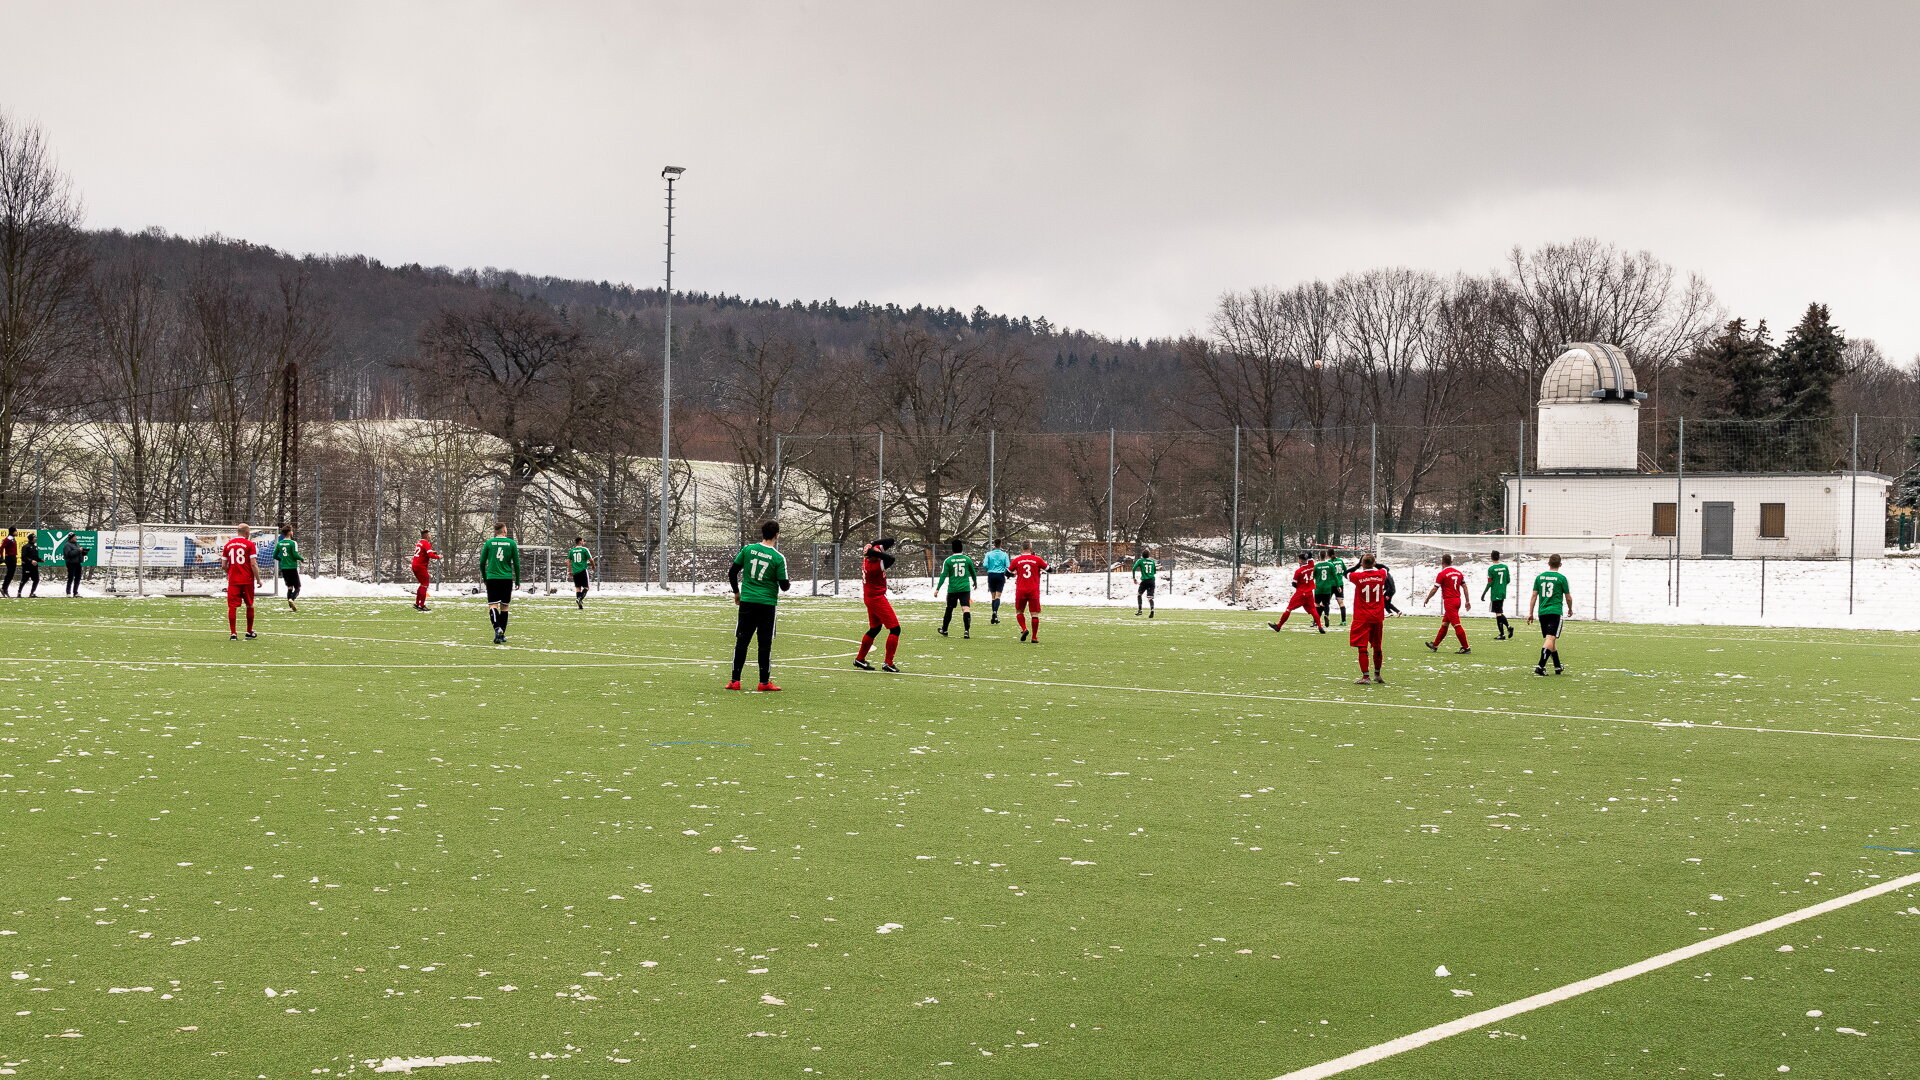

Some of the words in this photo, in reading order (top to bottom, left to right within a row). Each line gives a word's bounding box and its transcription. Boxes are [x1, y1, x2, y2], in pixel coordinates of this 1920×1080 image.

[202, 547, 216, 555] DAS
[228, 548, 246, 565] 18
[282, 547, 288, 557] 3
[496, 547, 504, 561] 4
[573, 552, 582, 563] 10
[750, 558, 769, 581] 17
[952, 563, 966, 577] 15
[1022, 564, 1032, 579] 3
[1144, 564, 1153, 574] 11
[1321, 569, 1327, 581] 8
[1451, 576, 1458, 590] 7
[1498, 572, 1504, 585] 7
[1361, 584, 1380, 603] 11
[1540, 582, 1555, 598] 13
